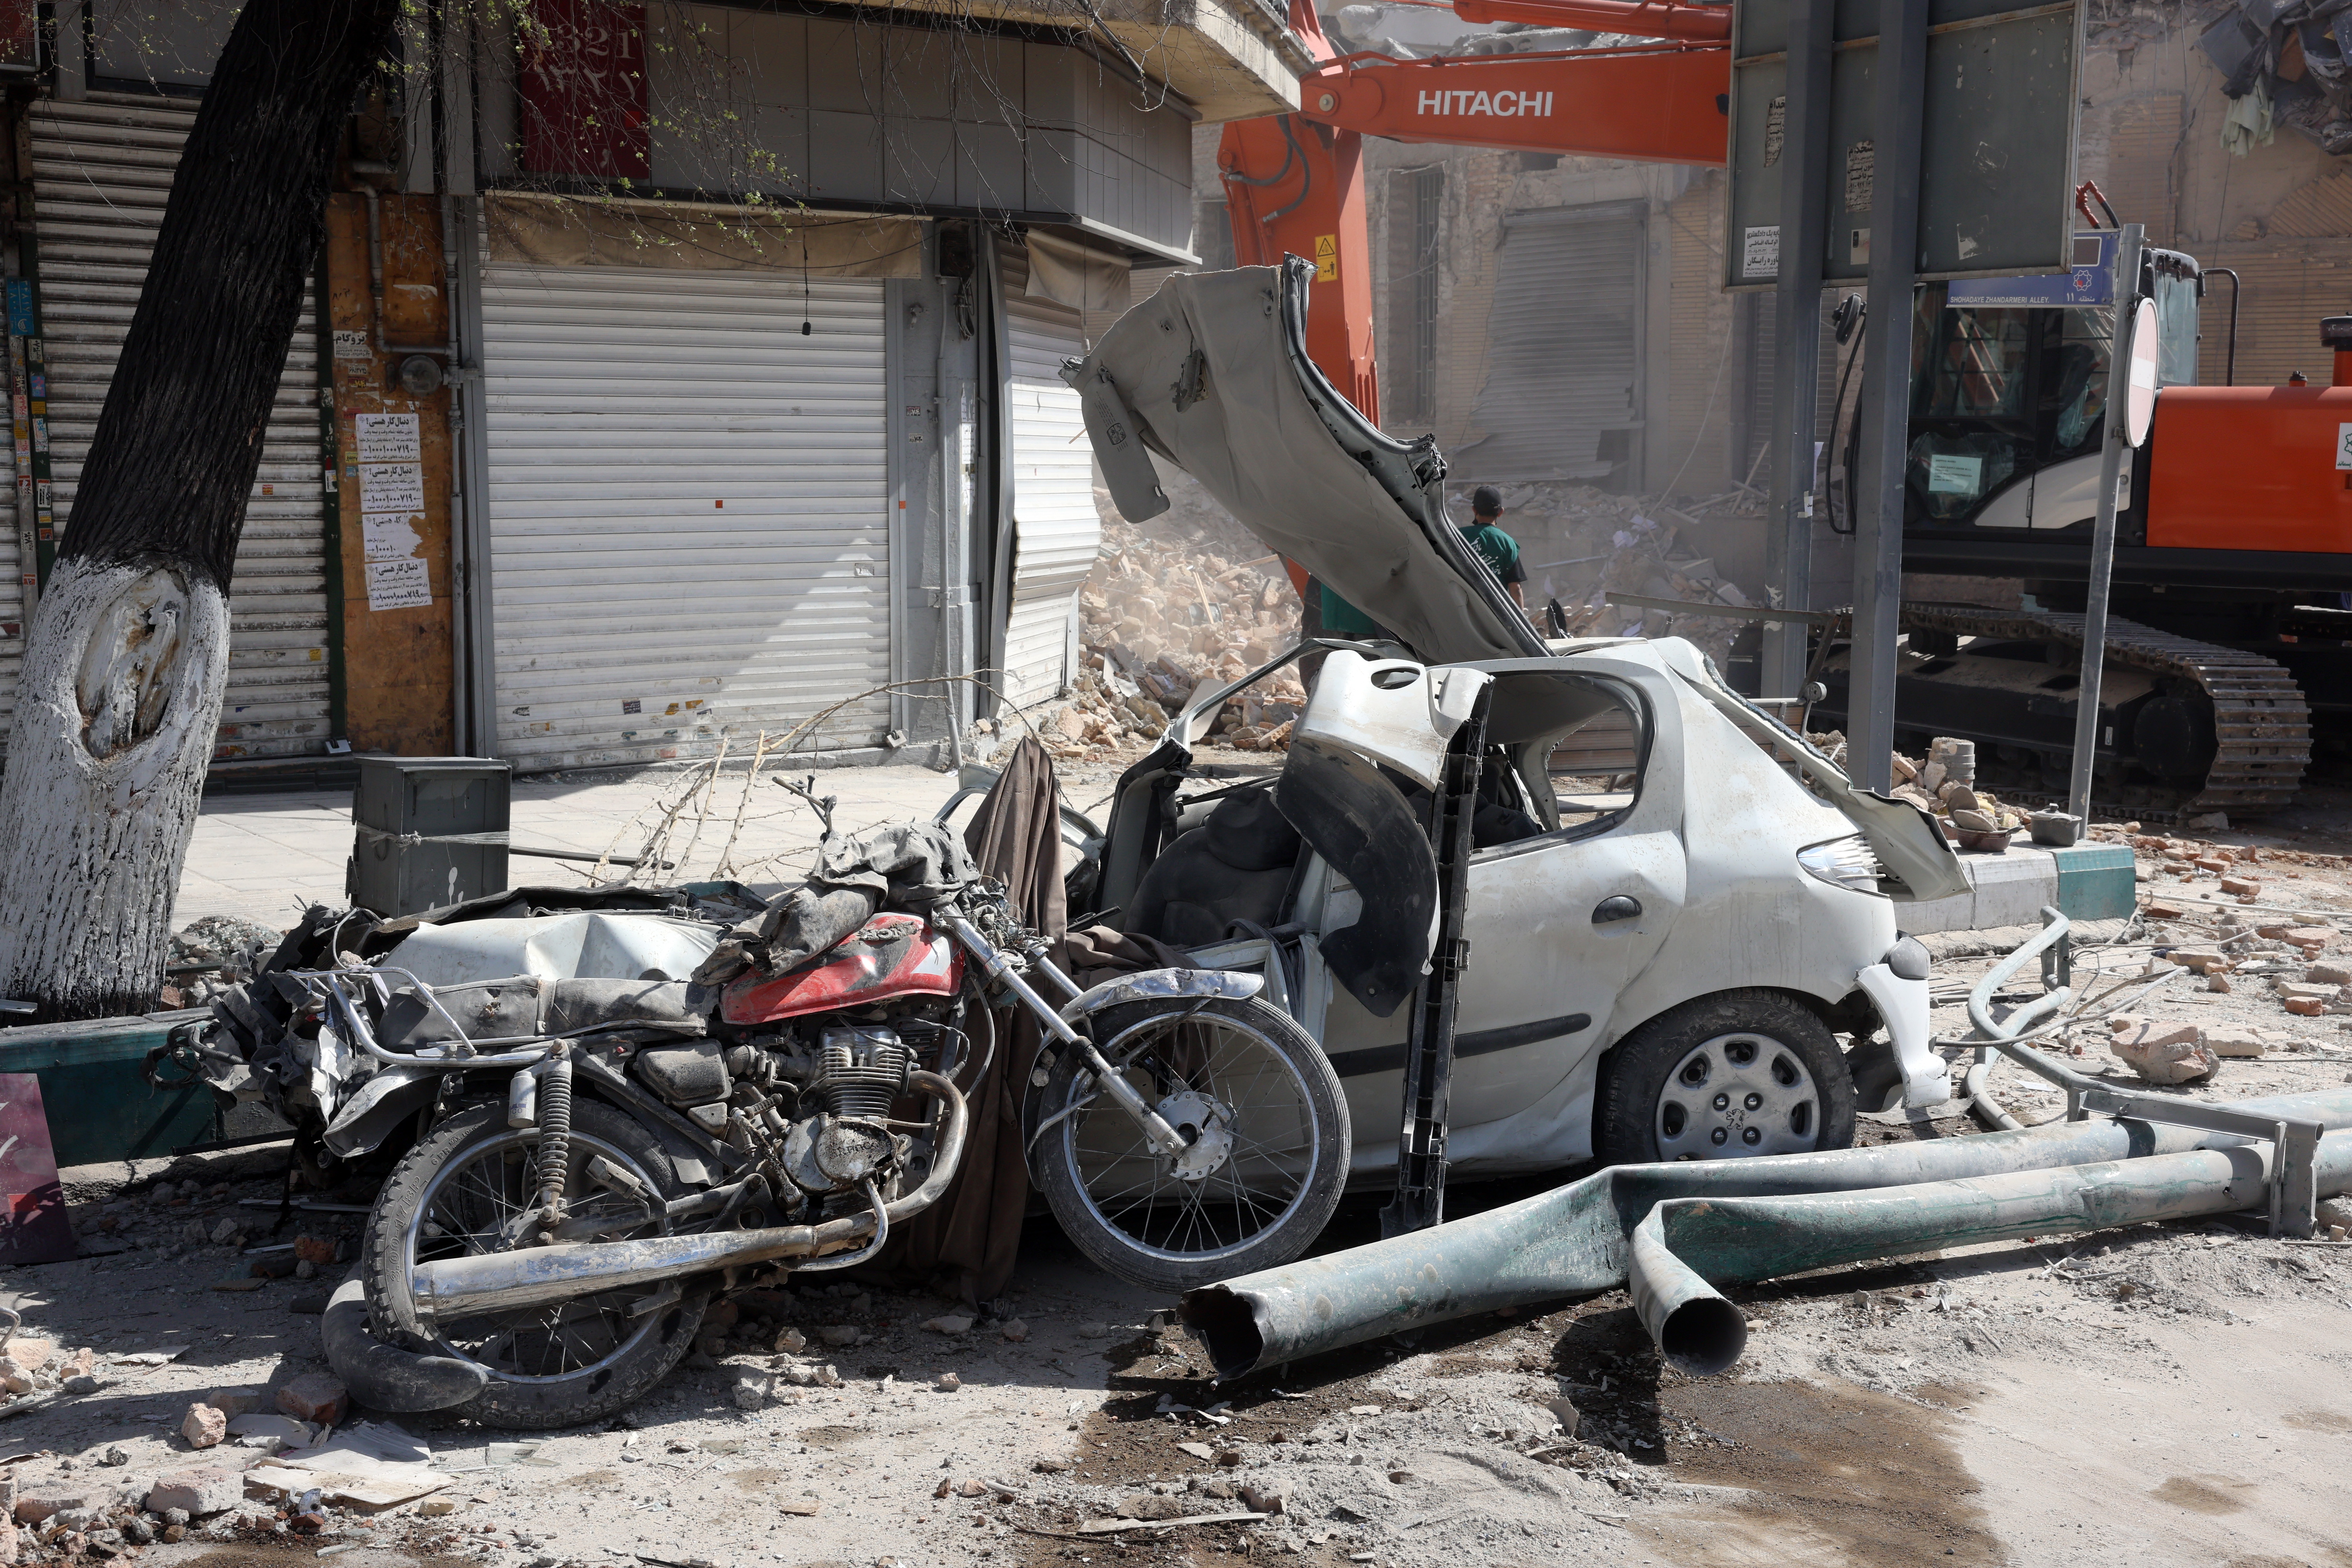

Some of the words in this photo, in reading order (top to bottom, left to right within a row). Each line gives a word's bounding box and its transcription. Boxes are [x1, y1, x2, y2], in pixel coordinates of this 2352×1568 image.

[1418, 90, 1553, 116] HITACHI
[1747, 230, 1765, 239] دادگستری
[1747, 256, 1766, 266] رایگان
[2067, 292, 2074, 301] ۱۱
[387, 417, 395, 427] کار
[395, 416, 409, 427] دنبال
[369, 444, 409, 453] ۱۰۰۰۱۰۰۰۷۱۹
[389, 466, 397, 477] کار
[398, 466, 412, 476] دنبال
[372, 493, 412, 503] ۱۰۰۰۱۰۰۰۷۱۹
[404, 562, 418, 573] دنبال
[448, 1134, 463, 1147] MAX.
[437, 1146, 452, 1160] PR
